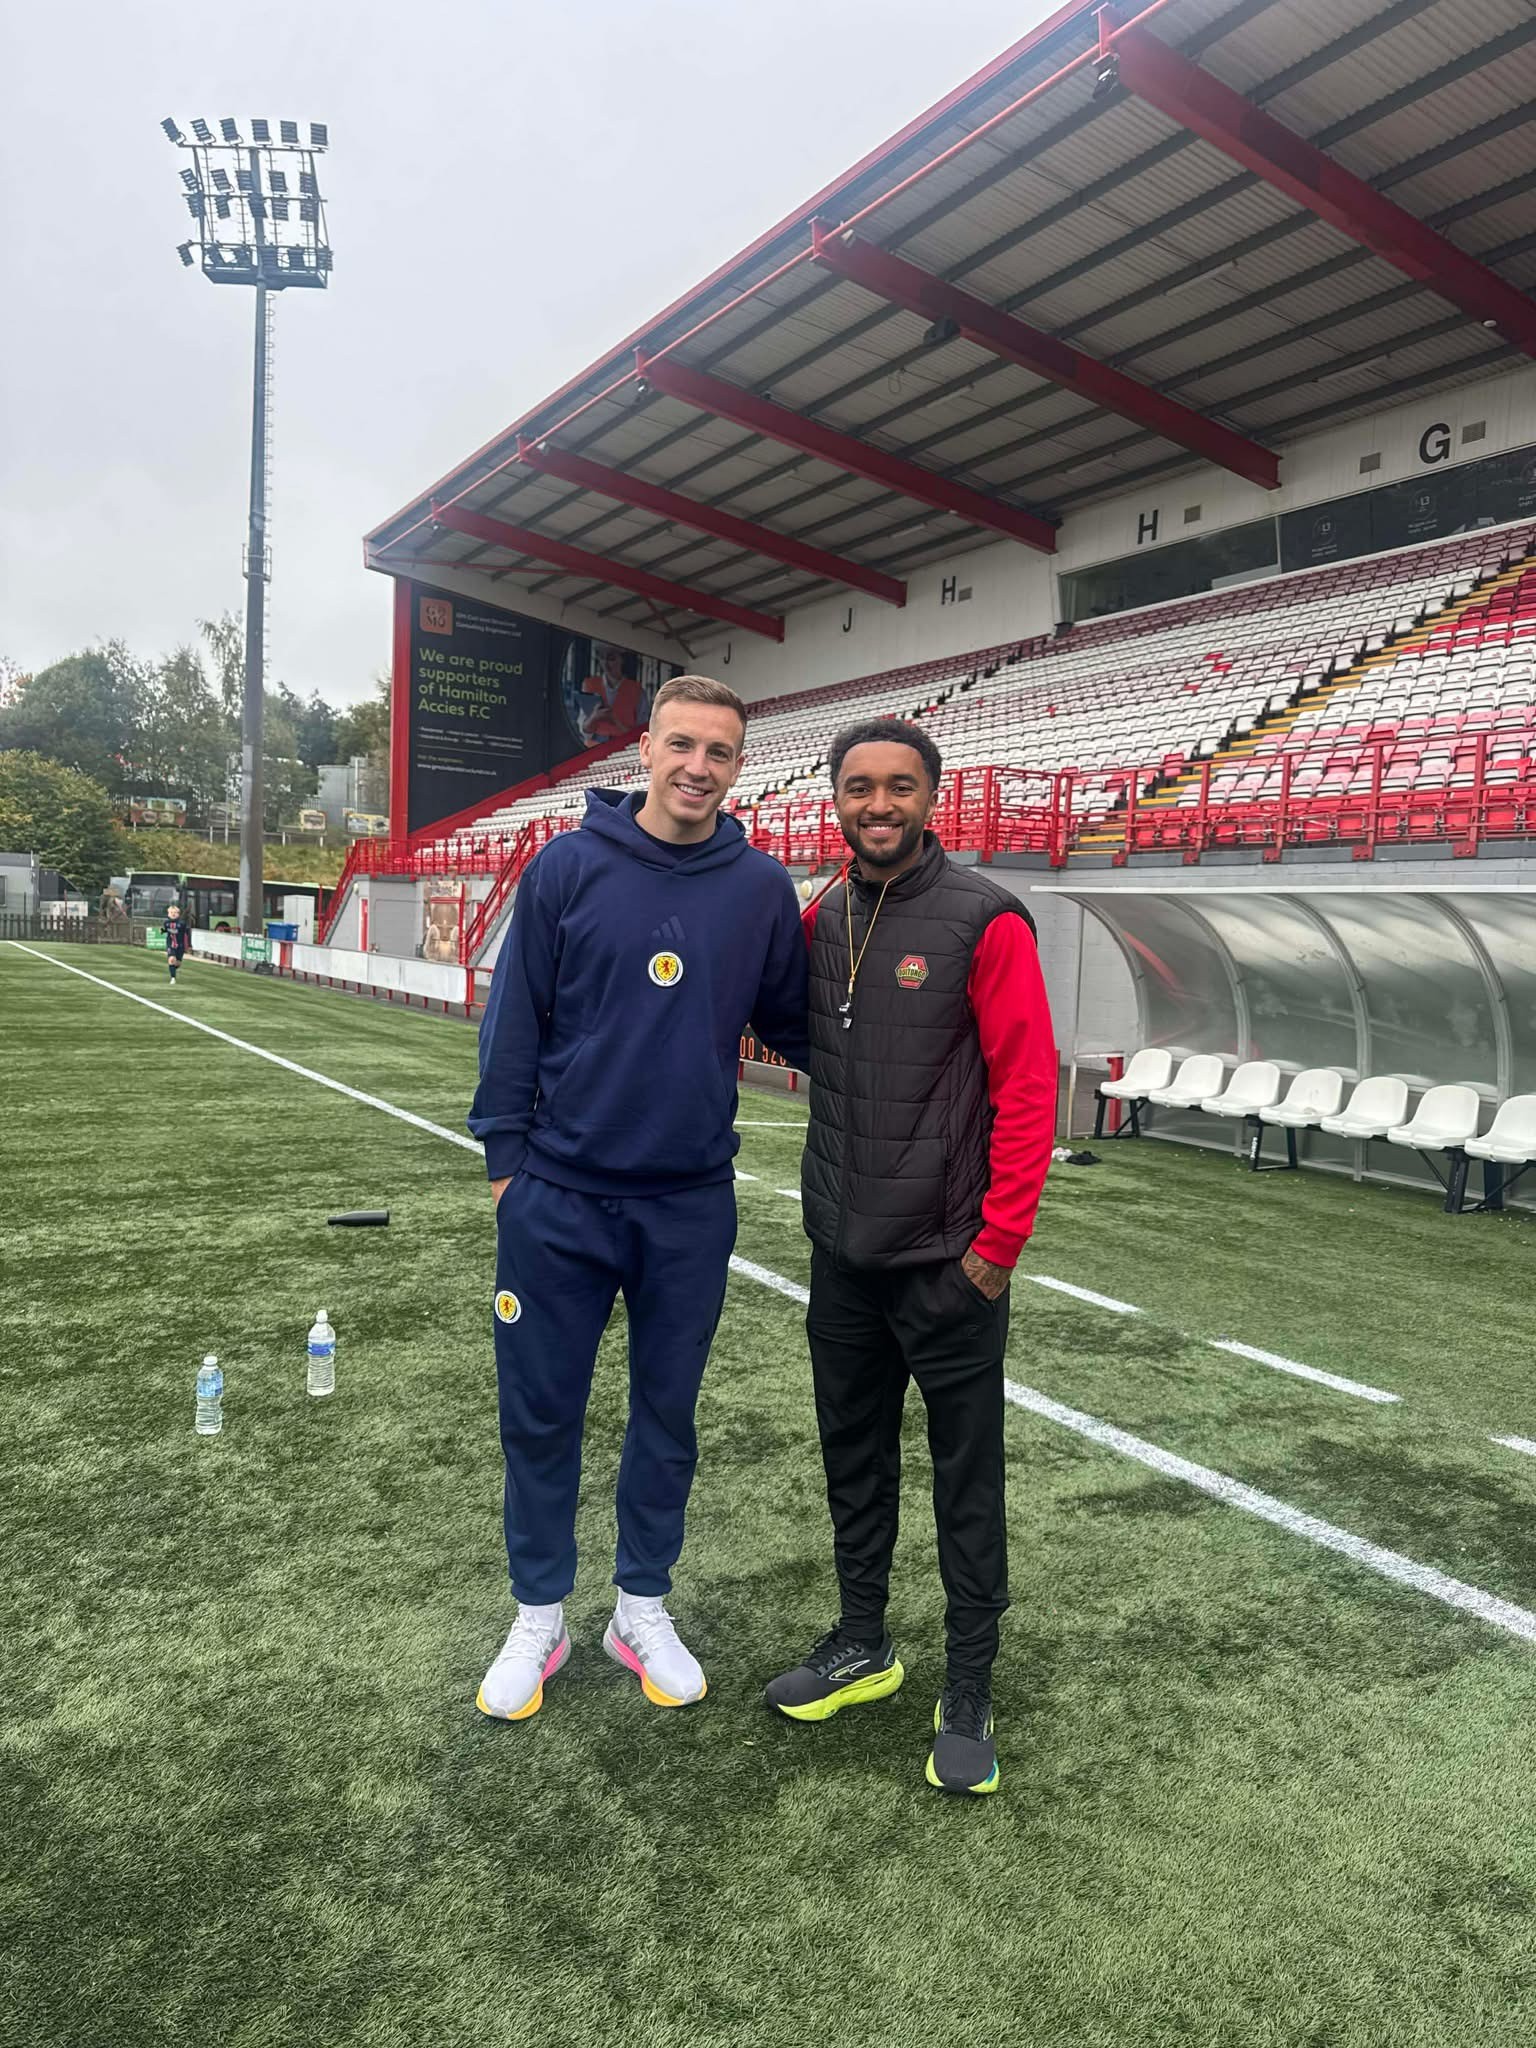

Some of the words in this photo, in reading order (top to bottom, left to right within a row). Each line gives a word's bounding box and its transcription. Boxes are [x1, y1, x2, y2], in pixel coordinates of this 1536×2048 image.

[1419, 423, 1451, 464] G
[1137, 509, 1159, 545] H
[941, 575, 956, 605] H
[842, 608, 853, 632] J
[419, 647, 446, 663] We
[449, 655, 475, 668] are
[479, 659, 523, 675] proud
[723, 642, 732, 664] J
[418, 667, 500, 688] supporters
[418, 682, 435, 696] of
[439, 684, 507, 705] Hamilton
[418, 698, 465, 717] Accies
[469, 704, 491, 719] F.C
[740, 1035, 755, 1060] 00
